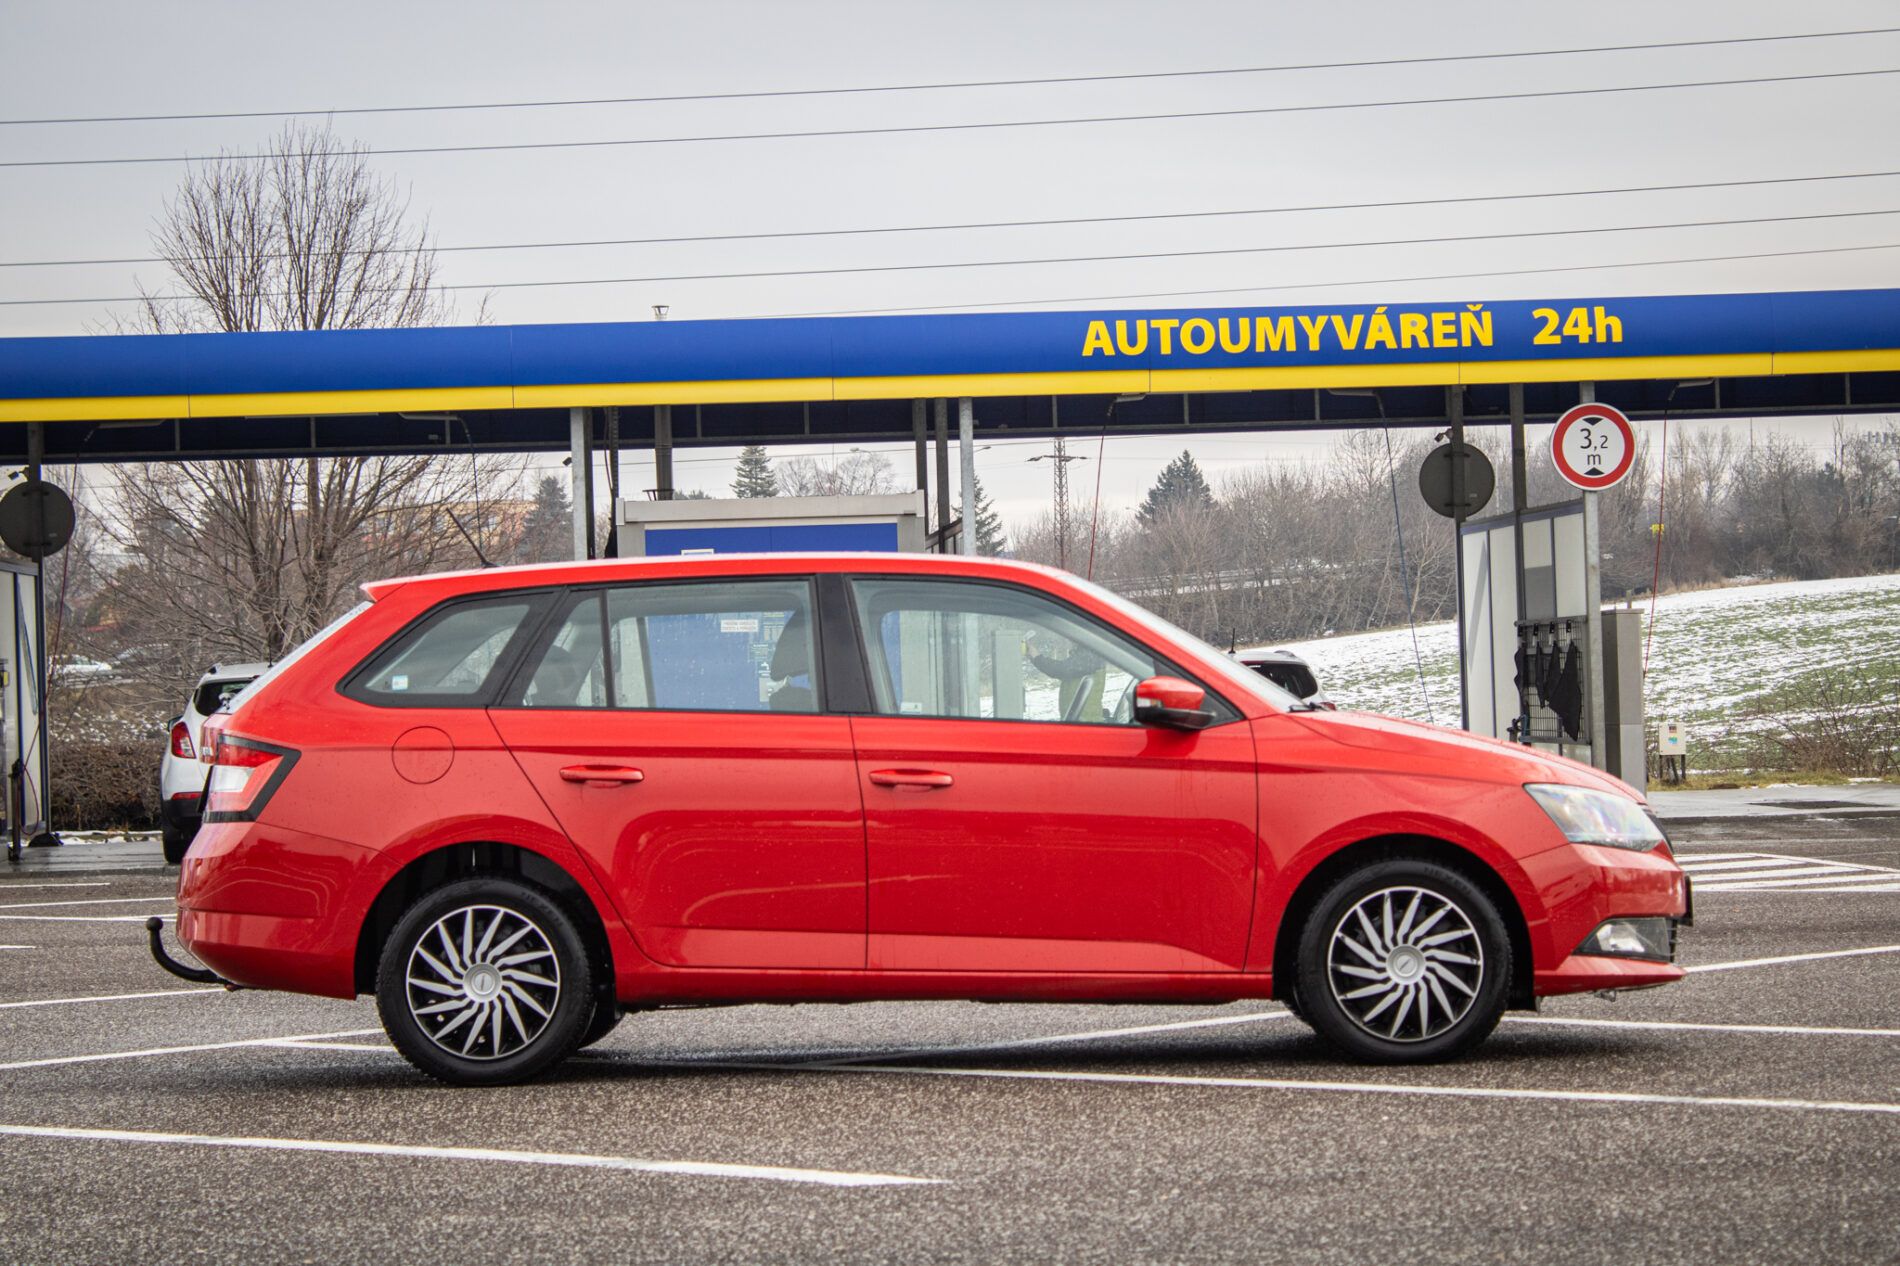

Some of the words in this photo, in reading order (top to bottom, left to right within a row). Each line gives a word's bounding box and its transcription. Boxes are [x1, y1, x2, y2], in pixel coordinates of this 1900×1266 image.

[1081, 303, 1494, 357] AUTOUMYVÁREŇ
[1531, 305, 1624, 345] 24h
[1579, 427, 1609, 451] 3,2
[1586, 453, 1602, 466] m
